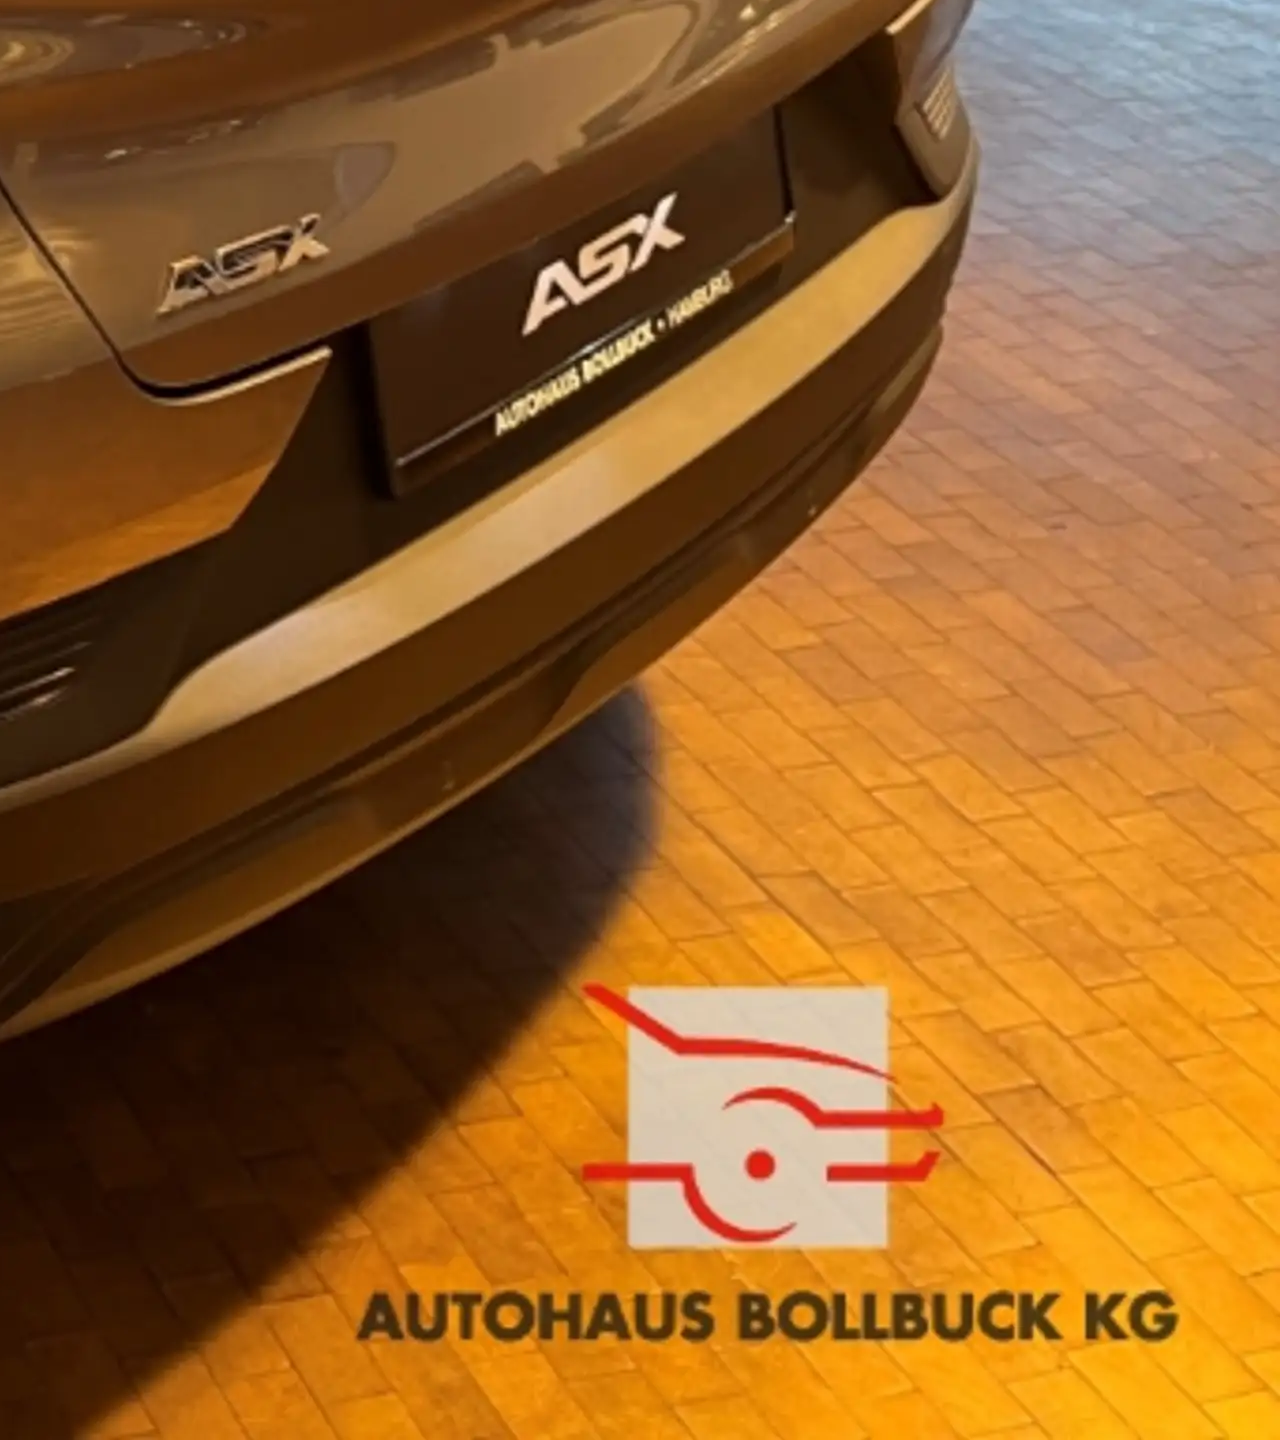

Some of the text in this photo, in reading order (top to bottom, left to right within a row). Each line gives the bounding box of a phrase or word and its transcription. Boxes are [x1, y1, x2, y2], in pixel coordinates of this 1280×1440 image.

[157, 212, 330, 315] ASX
[522, 191, 686, 337] ASX
[495, 268, 734, 437] AUTOHAUS BOLLBUCK HAMBURG
